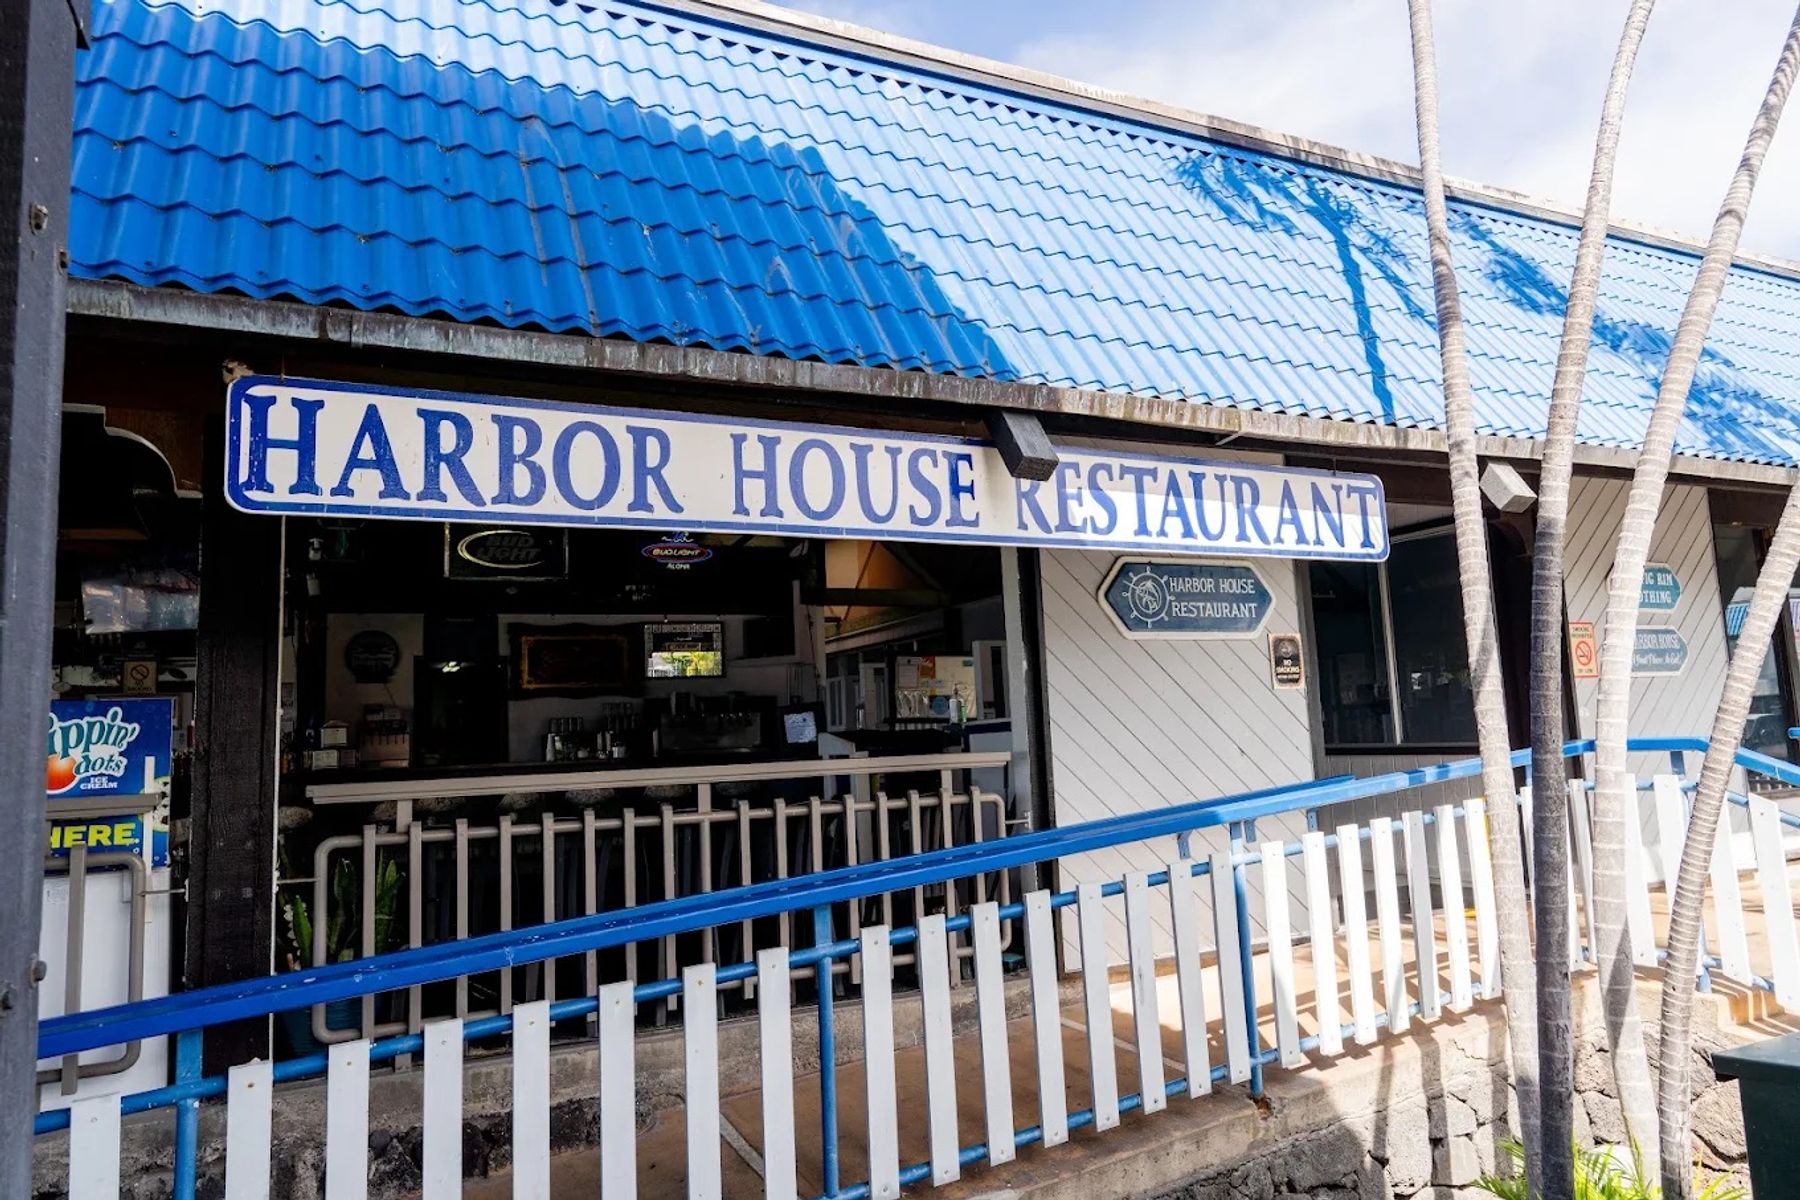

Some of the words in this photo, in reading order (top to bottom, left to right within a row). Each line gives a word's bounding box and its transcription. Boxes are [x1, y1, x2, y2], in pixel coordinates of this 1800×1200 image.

[240, 394, 685, 513] HARBOR
[730, 432, 980, 528] HOUSE
[1015, 459, 1378, 549] RESTAURANT
[486, 534, 536, 548] BUD
[1169, 577, 1216, 593] HARBOR
[1219, 578, 1256, 595] HOUSE
[1638, 590, 1672, 604] OTHING
[1171, 602, 1258, 618] RESTAURANT
[48, 710, 137, 760] ippin'
[75, 753, 124, 775] dots
[79, 781, 118, 790] CREAM
[90, 776, 109, 784] ICE
